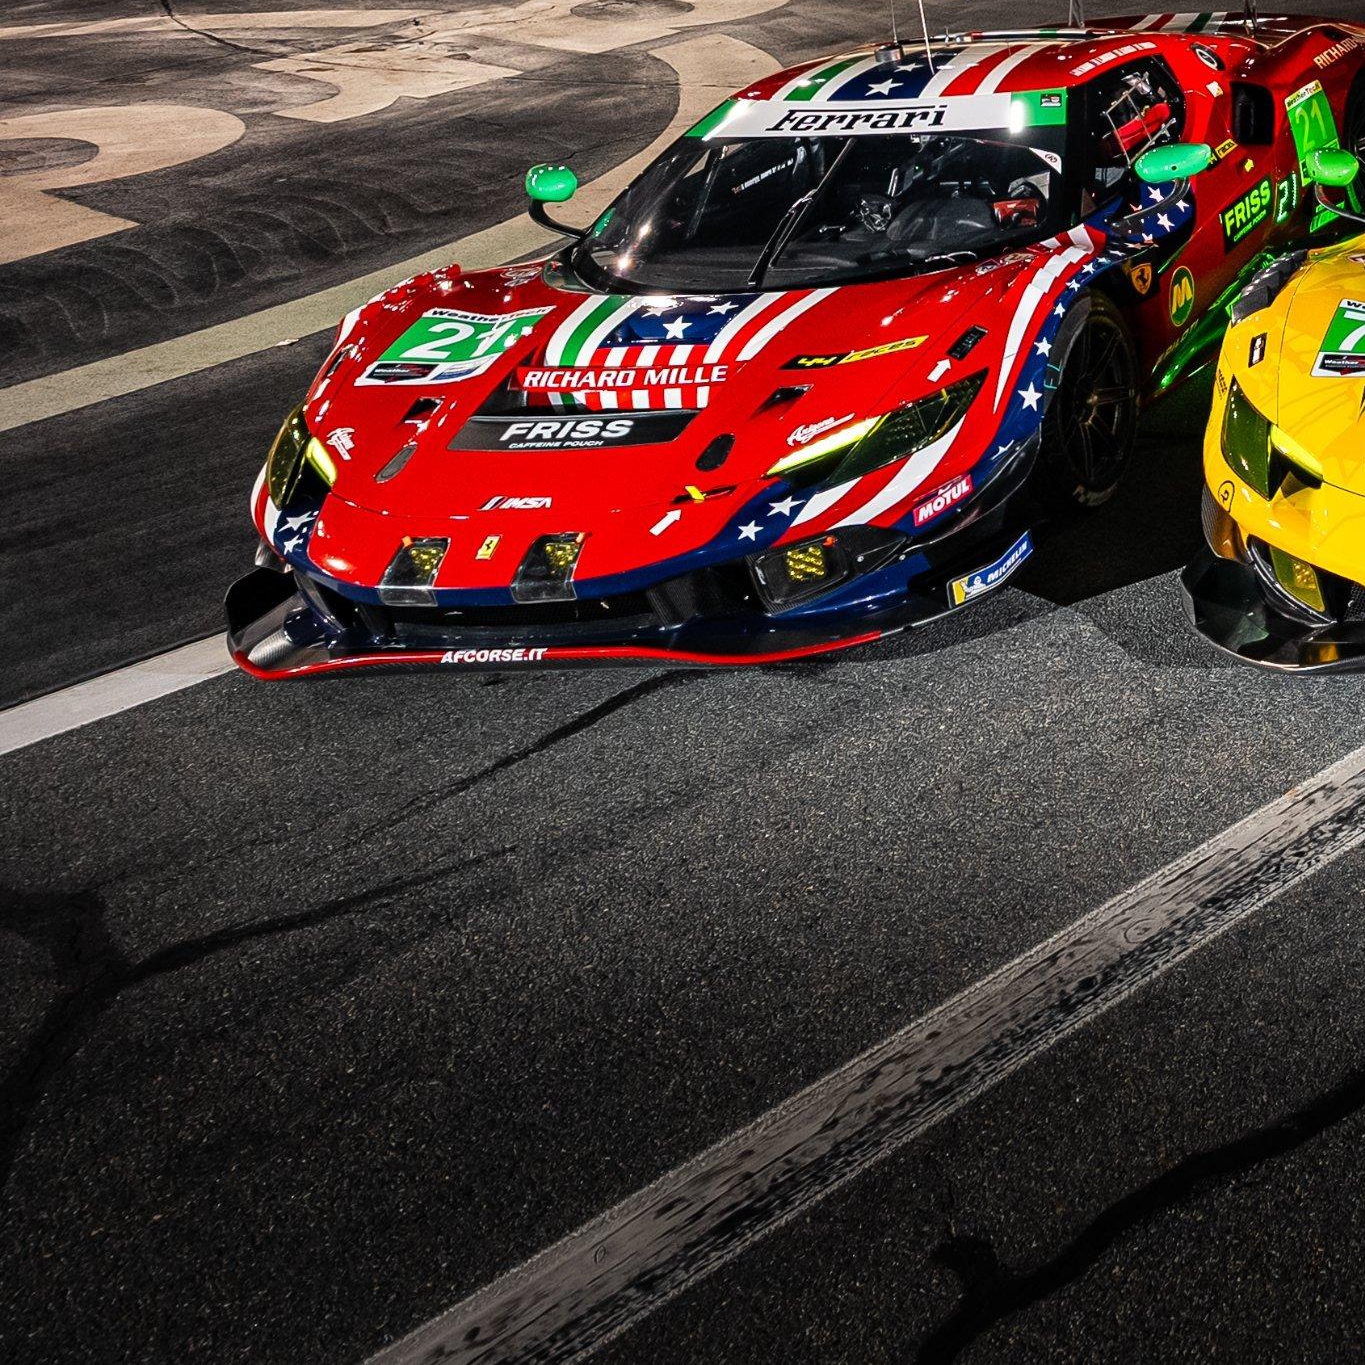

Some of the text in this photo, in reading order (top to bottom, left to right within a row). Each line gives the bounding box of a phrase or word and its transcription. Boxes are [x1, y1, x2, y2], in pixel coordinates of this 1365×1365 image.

[765, 104, 948, 132] Ferrari
[1295, 99, 1327, 154] 21
[1225, 179, 1272, 236] FRISS
[1276, 173, 1297, 223] 21
[399, 319, 517, 360] 21
[523, 365, 729, 388] RICHARD MILLE
[500, 419, 635, 442] FRISS
[508, 441, 563, 449] CAFFEINE
[500, 496, 552, 509] IMSA
[918, 478, 970, 522] MOTUL
[987, 541, 1028, 583] MICHELIN
[441, 648, 548, 663] AFCORSE.IT
